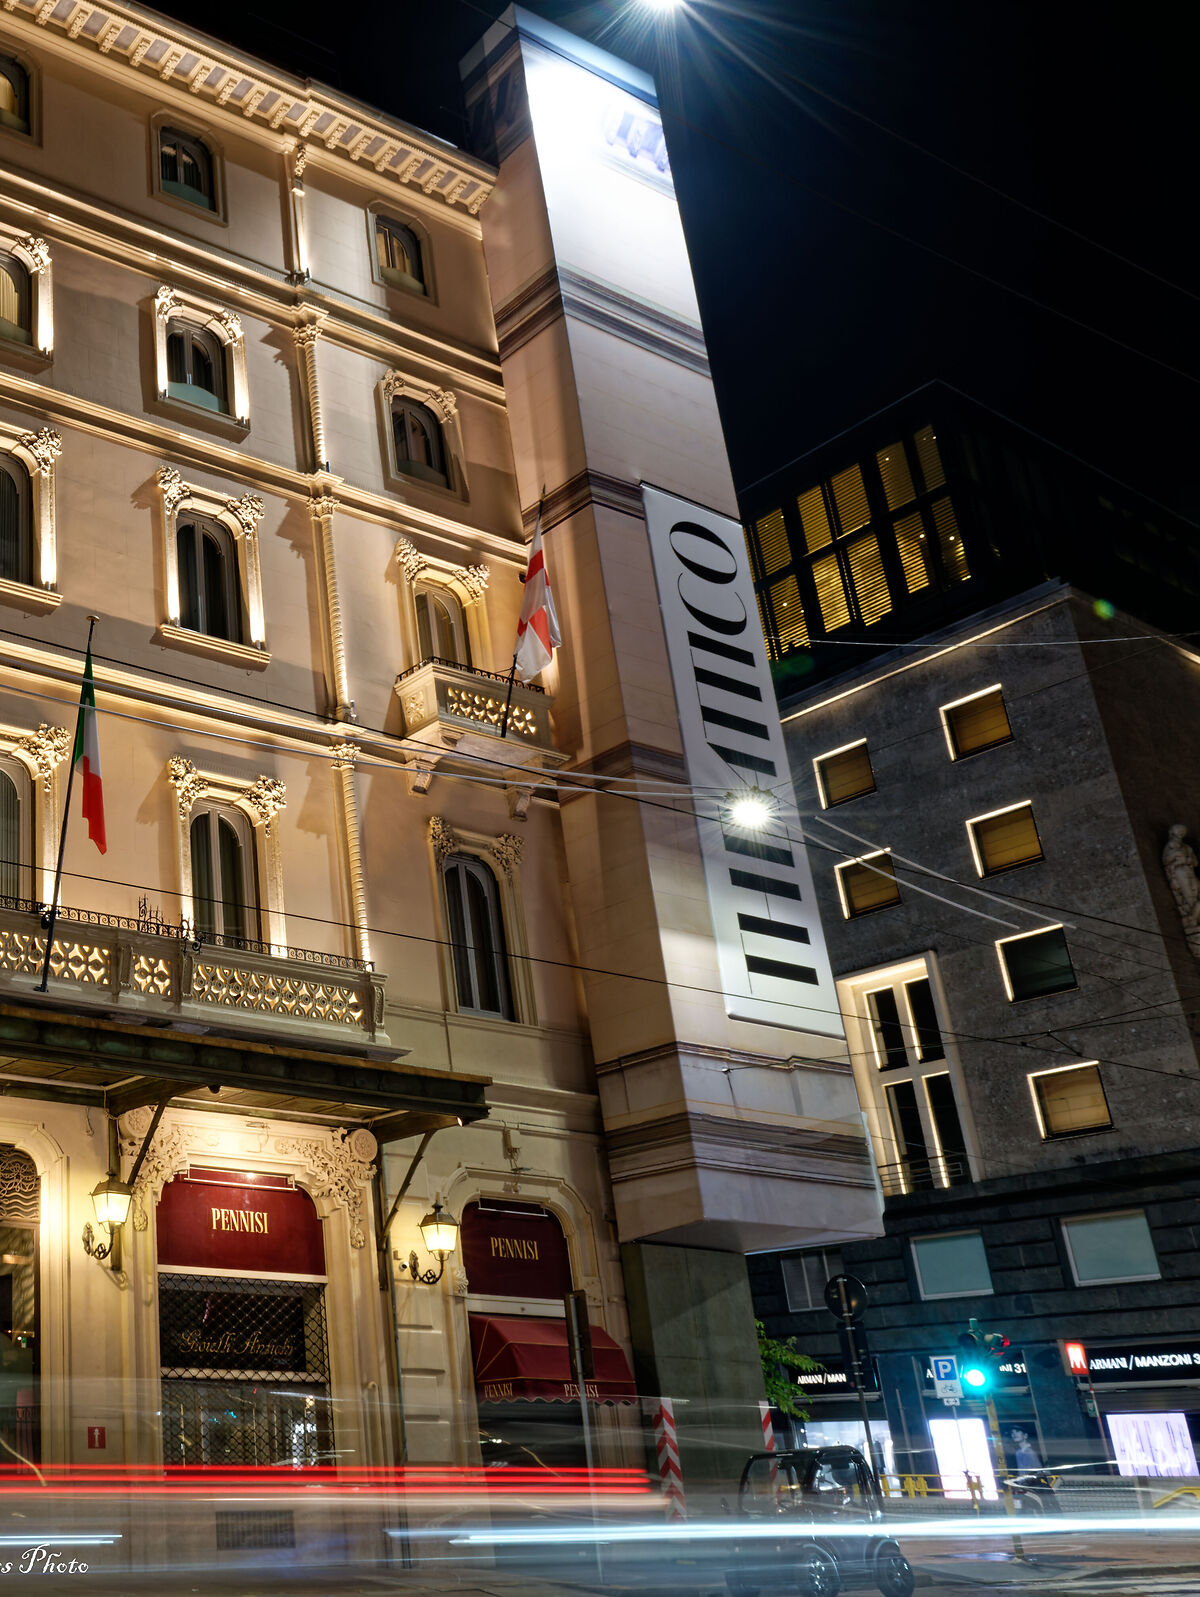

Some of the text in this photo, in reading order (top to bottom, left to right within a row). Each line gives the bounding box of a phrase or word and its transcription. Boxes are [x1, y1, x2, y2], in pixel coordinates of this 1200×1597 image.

[211, 1207, 269, 1234] PENNISI
[490, 1236, 539, 1261] PENNISI
[1089, 1357, 1129, 1370] ARMANI
[1135, 1353, 1193, 1368] MANZONI
[484, 1382, 513, 1398] PENNISI
